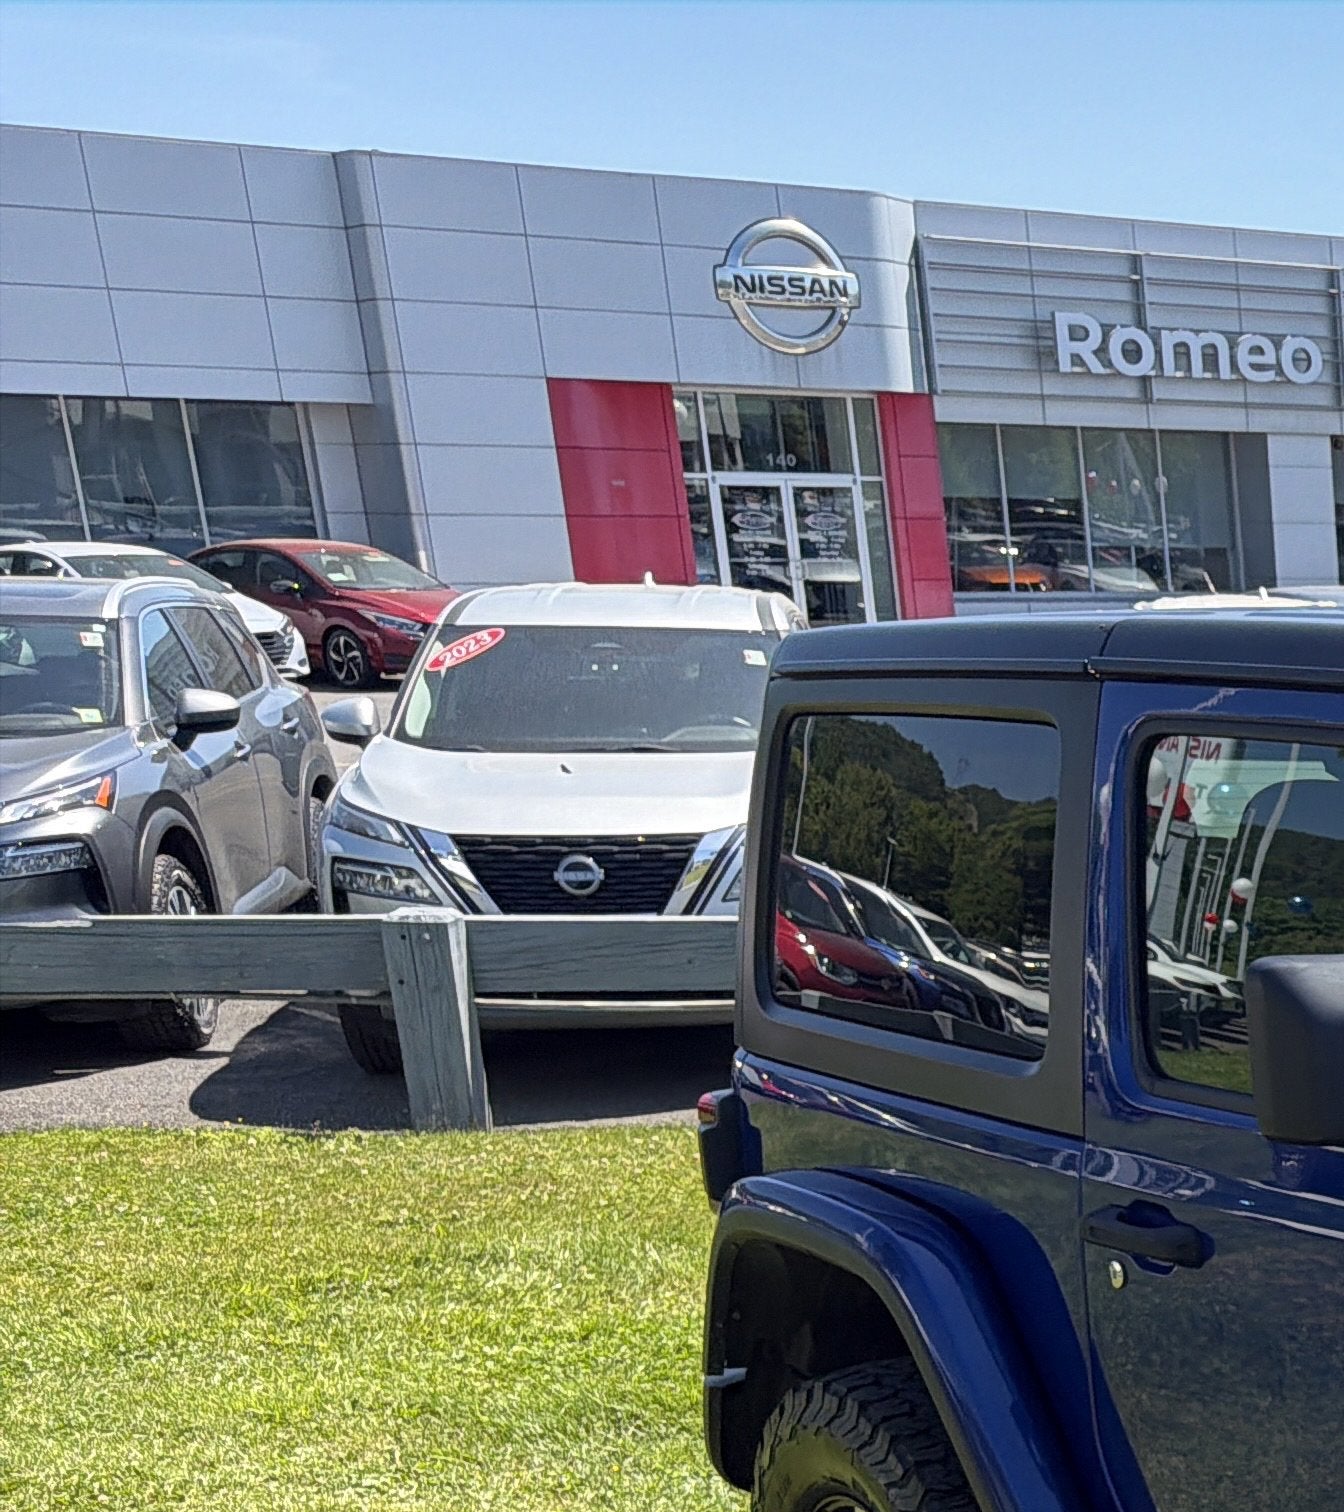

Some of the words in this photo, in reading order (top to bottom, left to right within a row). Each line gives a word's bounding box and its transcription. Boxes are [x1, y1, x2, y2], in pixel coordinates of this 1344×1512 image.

[733, 273, 849, 299] NISSAN
[1054, 311, 1324, 384] Romeo
[766, 453, 797, 467] 140
[439, 631, 493, 663] 2023
